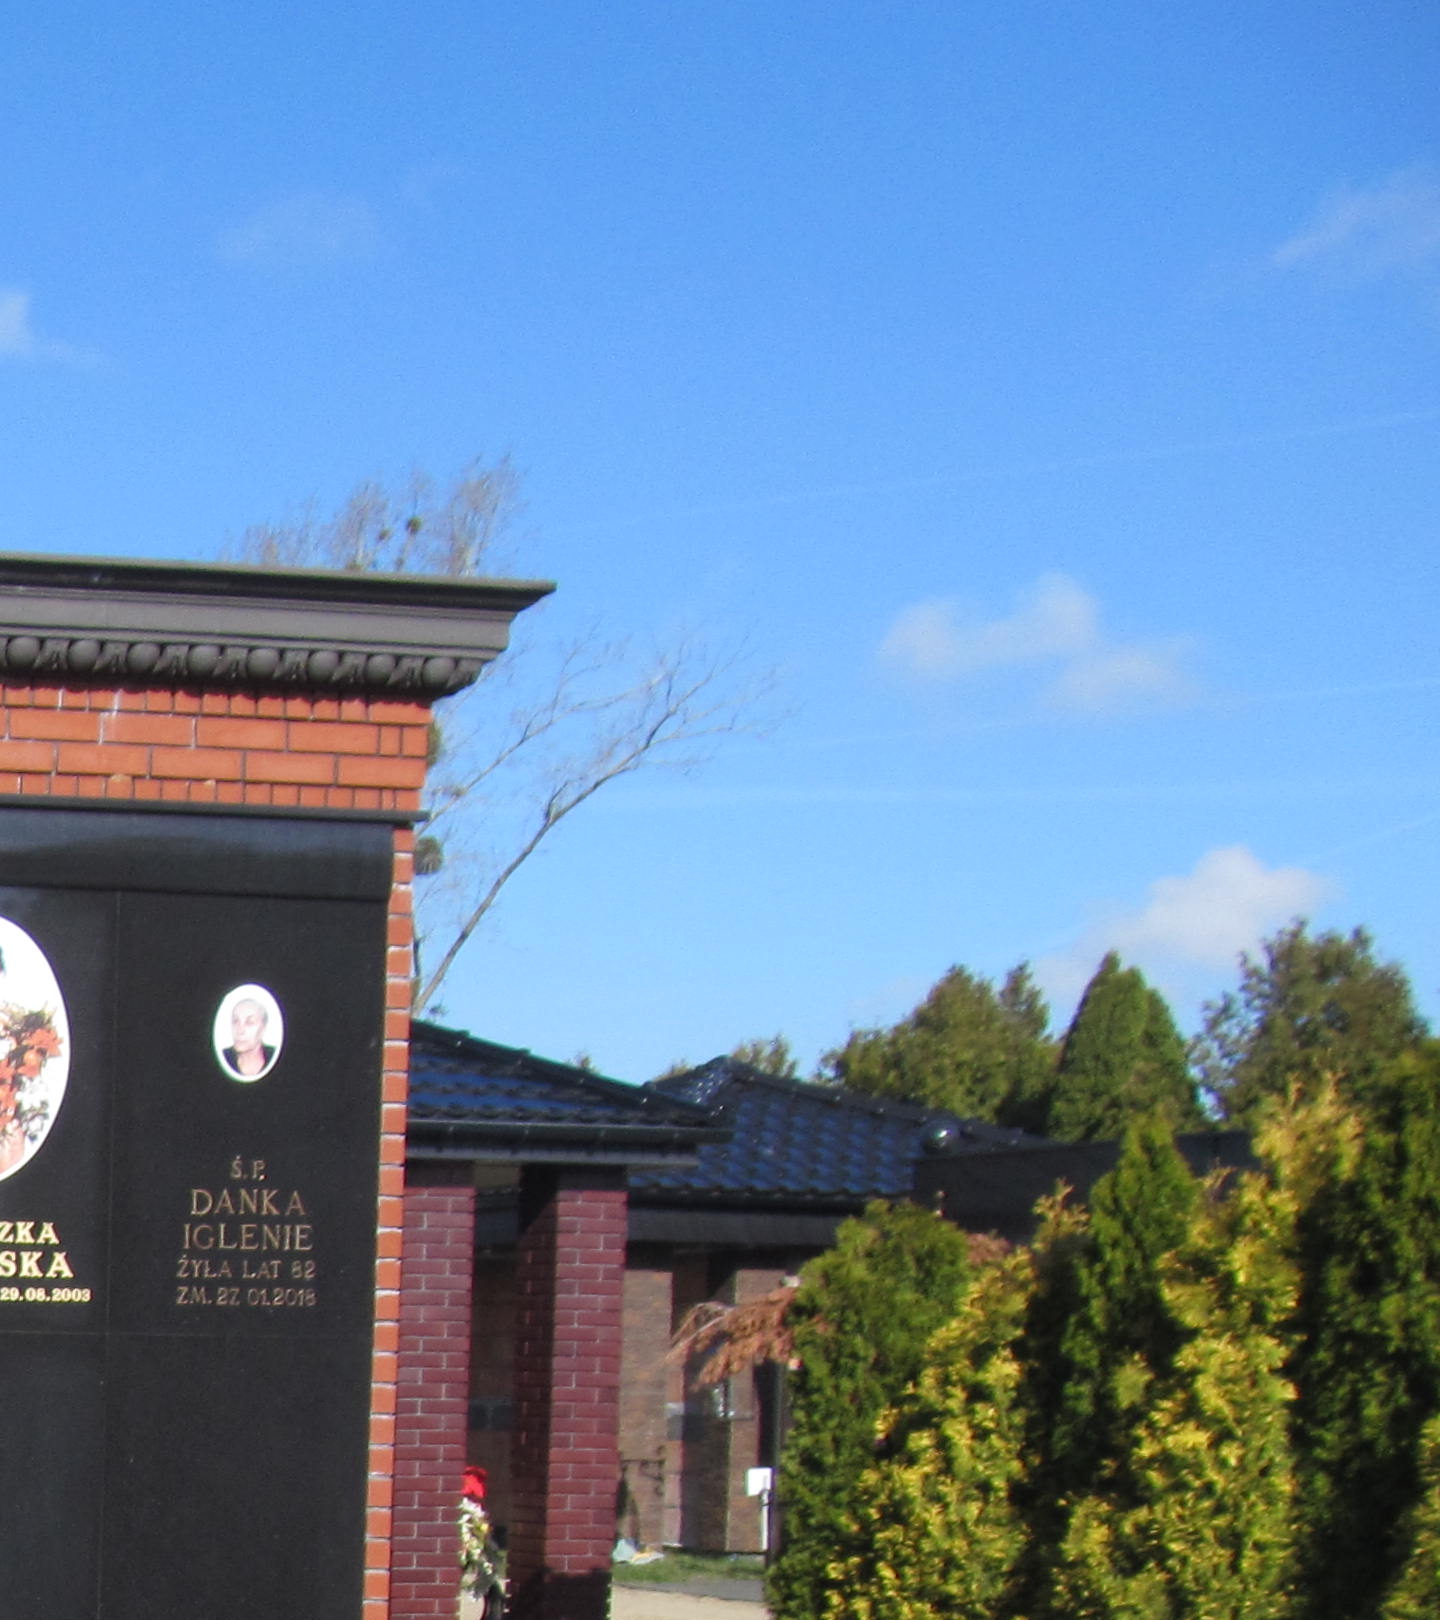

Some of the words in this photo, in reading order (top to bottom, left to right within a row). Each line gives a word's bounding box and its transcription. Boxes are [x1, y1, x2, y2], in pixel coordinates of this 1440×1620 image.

[191, 1188, 307, 1216] DANKA
[182, 1223, 313, 1251] IGLENIE
[176, 1254, 232, 1278] ŻYŁA
